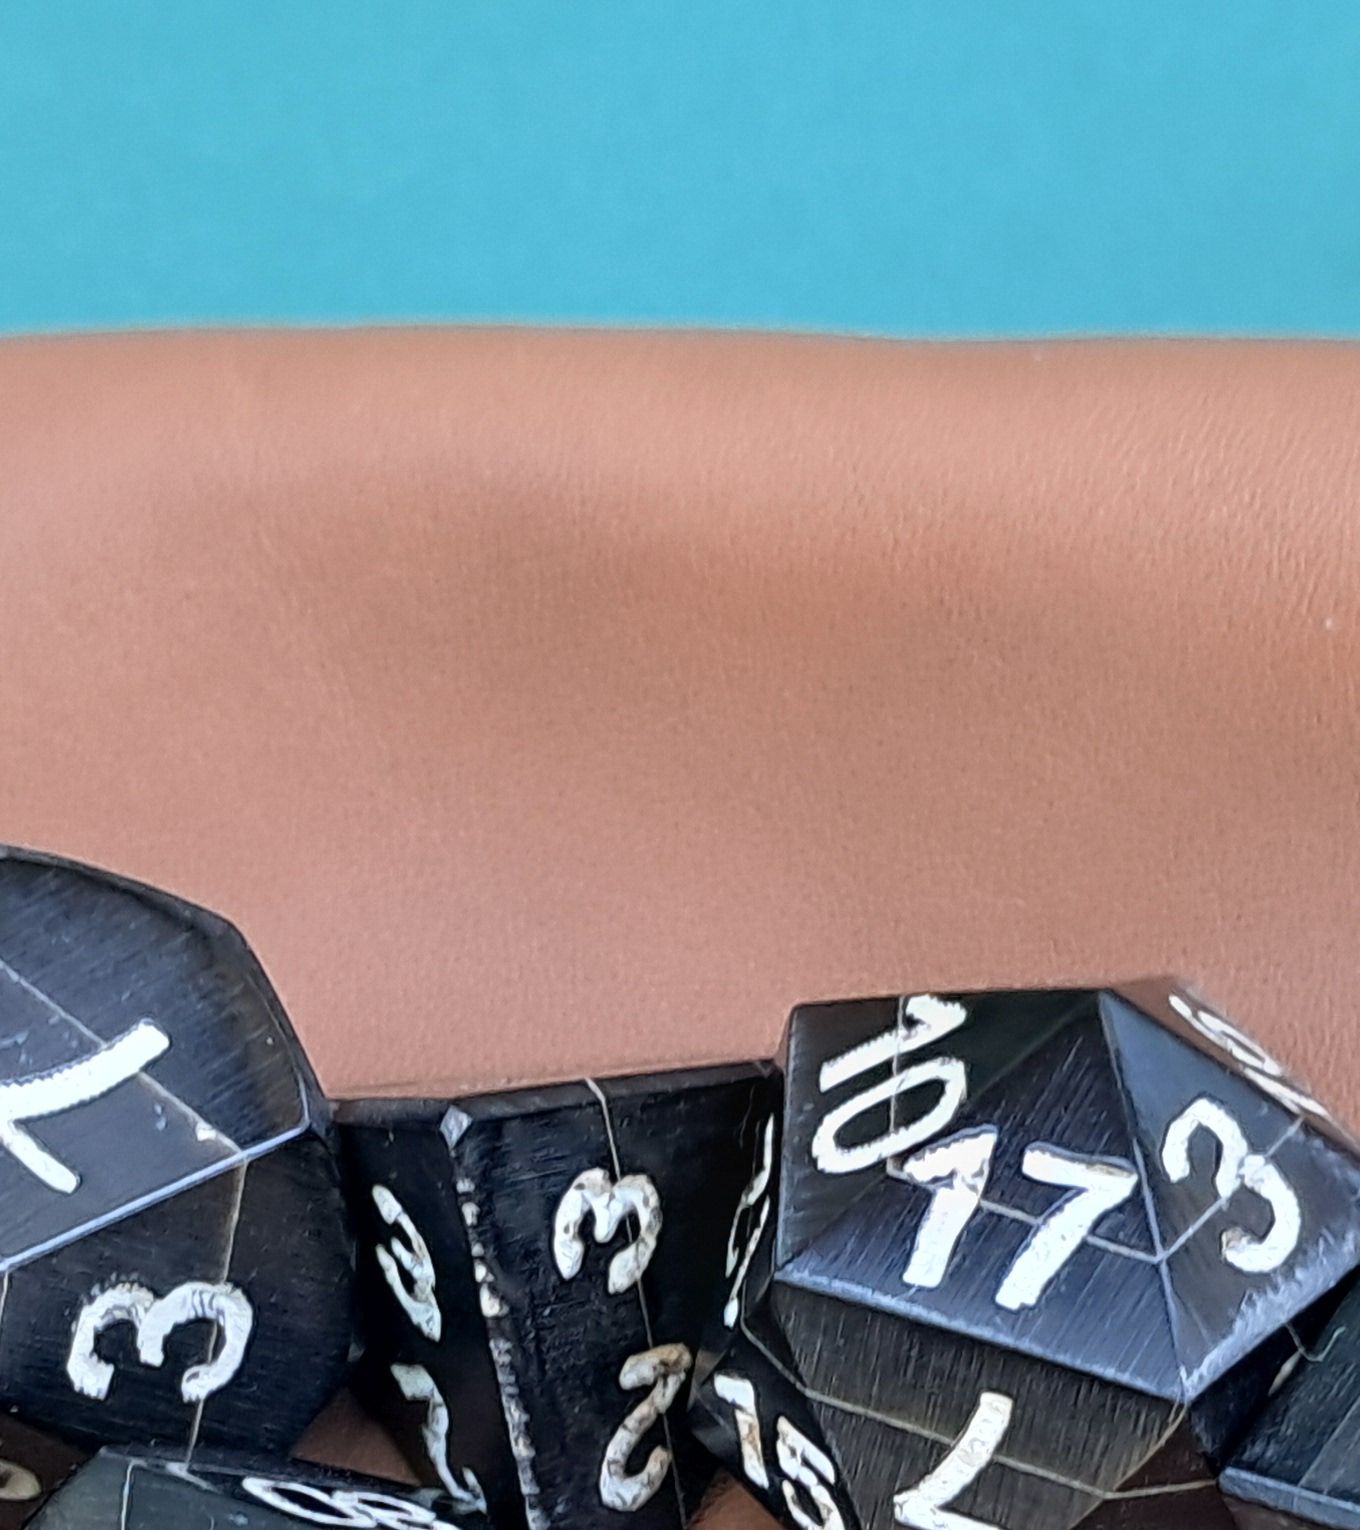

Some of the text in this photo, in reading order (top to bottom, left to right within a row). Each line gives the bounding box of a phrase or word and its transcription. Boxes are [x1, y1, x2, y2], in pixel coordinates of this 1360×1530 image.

[811, 994, 968, 1174] 10
[551, 1167, 663, 1295] 3
[902, 1125, 1138, 1312] 17
[1161, 1097, 1302, 1274] 3
[67, 1280, 253, 1402] 3
[600, 1342, 693, 1511] 2
